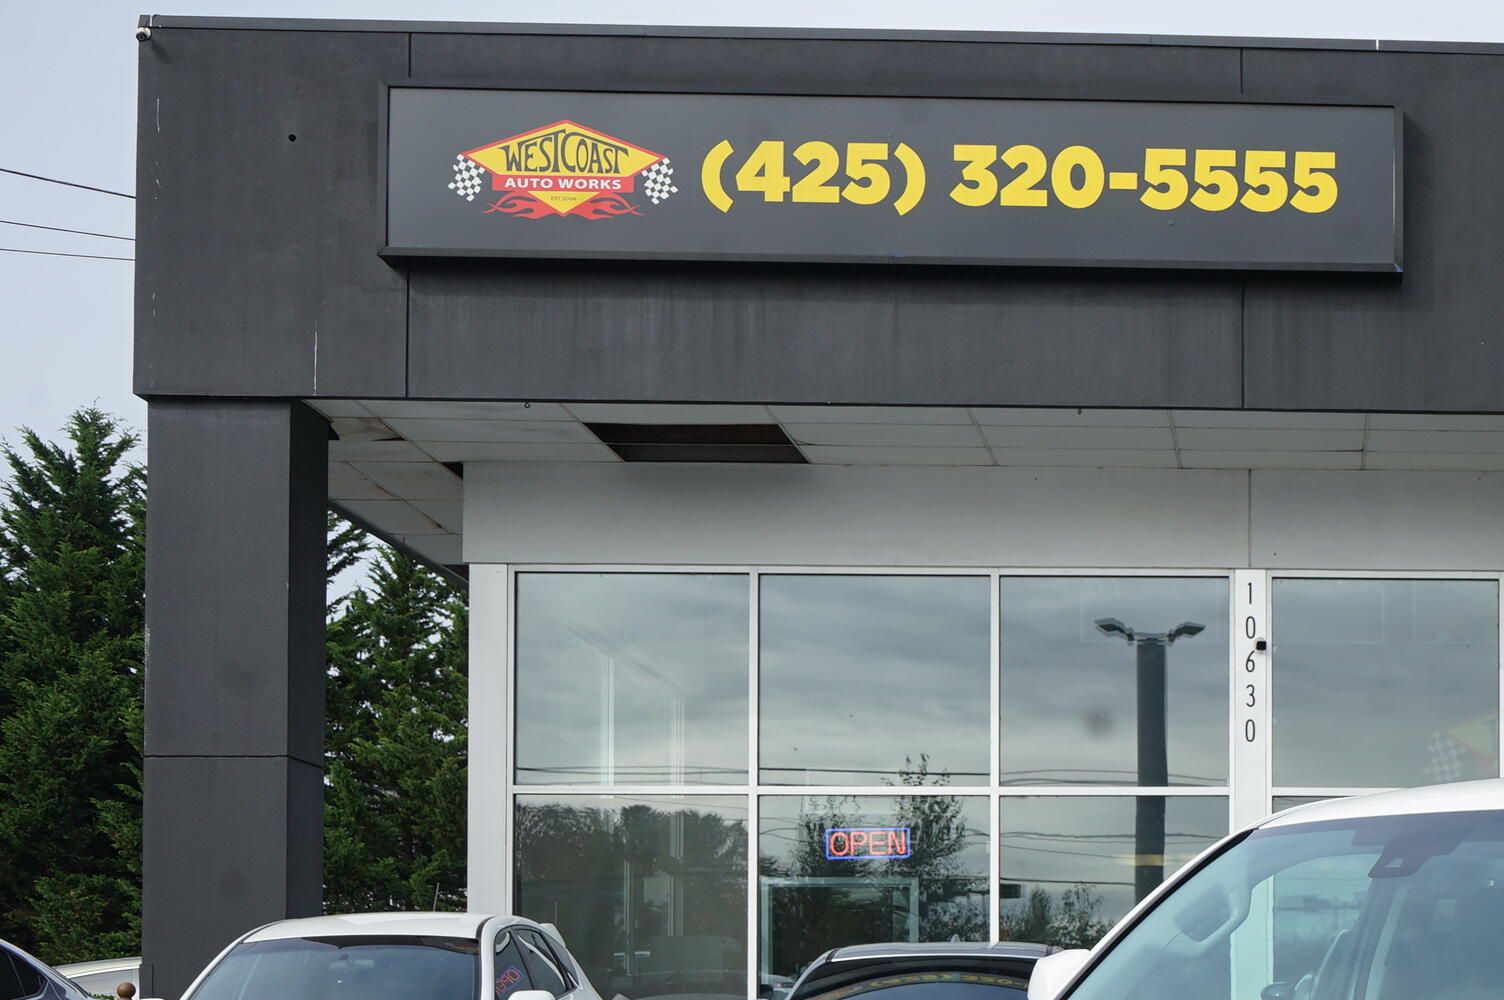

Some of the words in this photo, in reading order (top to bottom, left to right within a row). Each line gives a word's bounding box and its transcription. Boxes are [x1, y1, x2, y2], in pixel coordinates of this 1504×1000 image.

[504, 177, 554, 189] AUTO
[558, 178, 622, 190] WORKS
[701, 139, 926, 216] (425)
[949, 144, 1338, 214] 320-5555
[828, 831, 907, 856] OPEN
